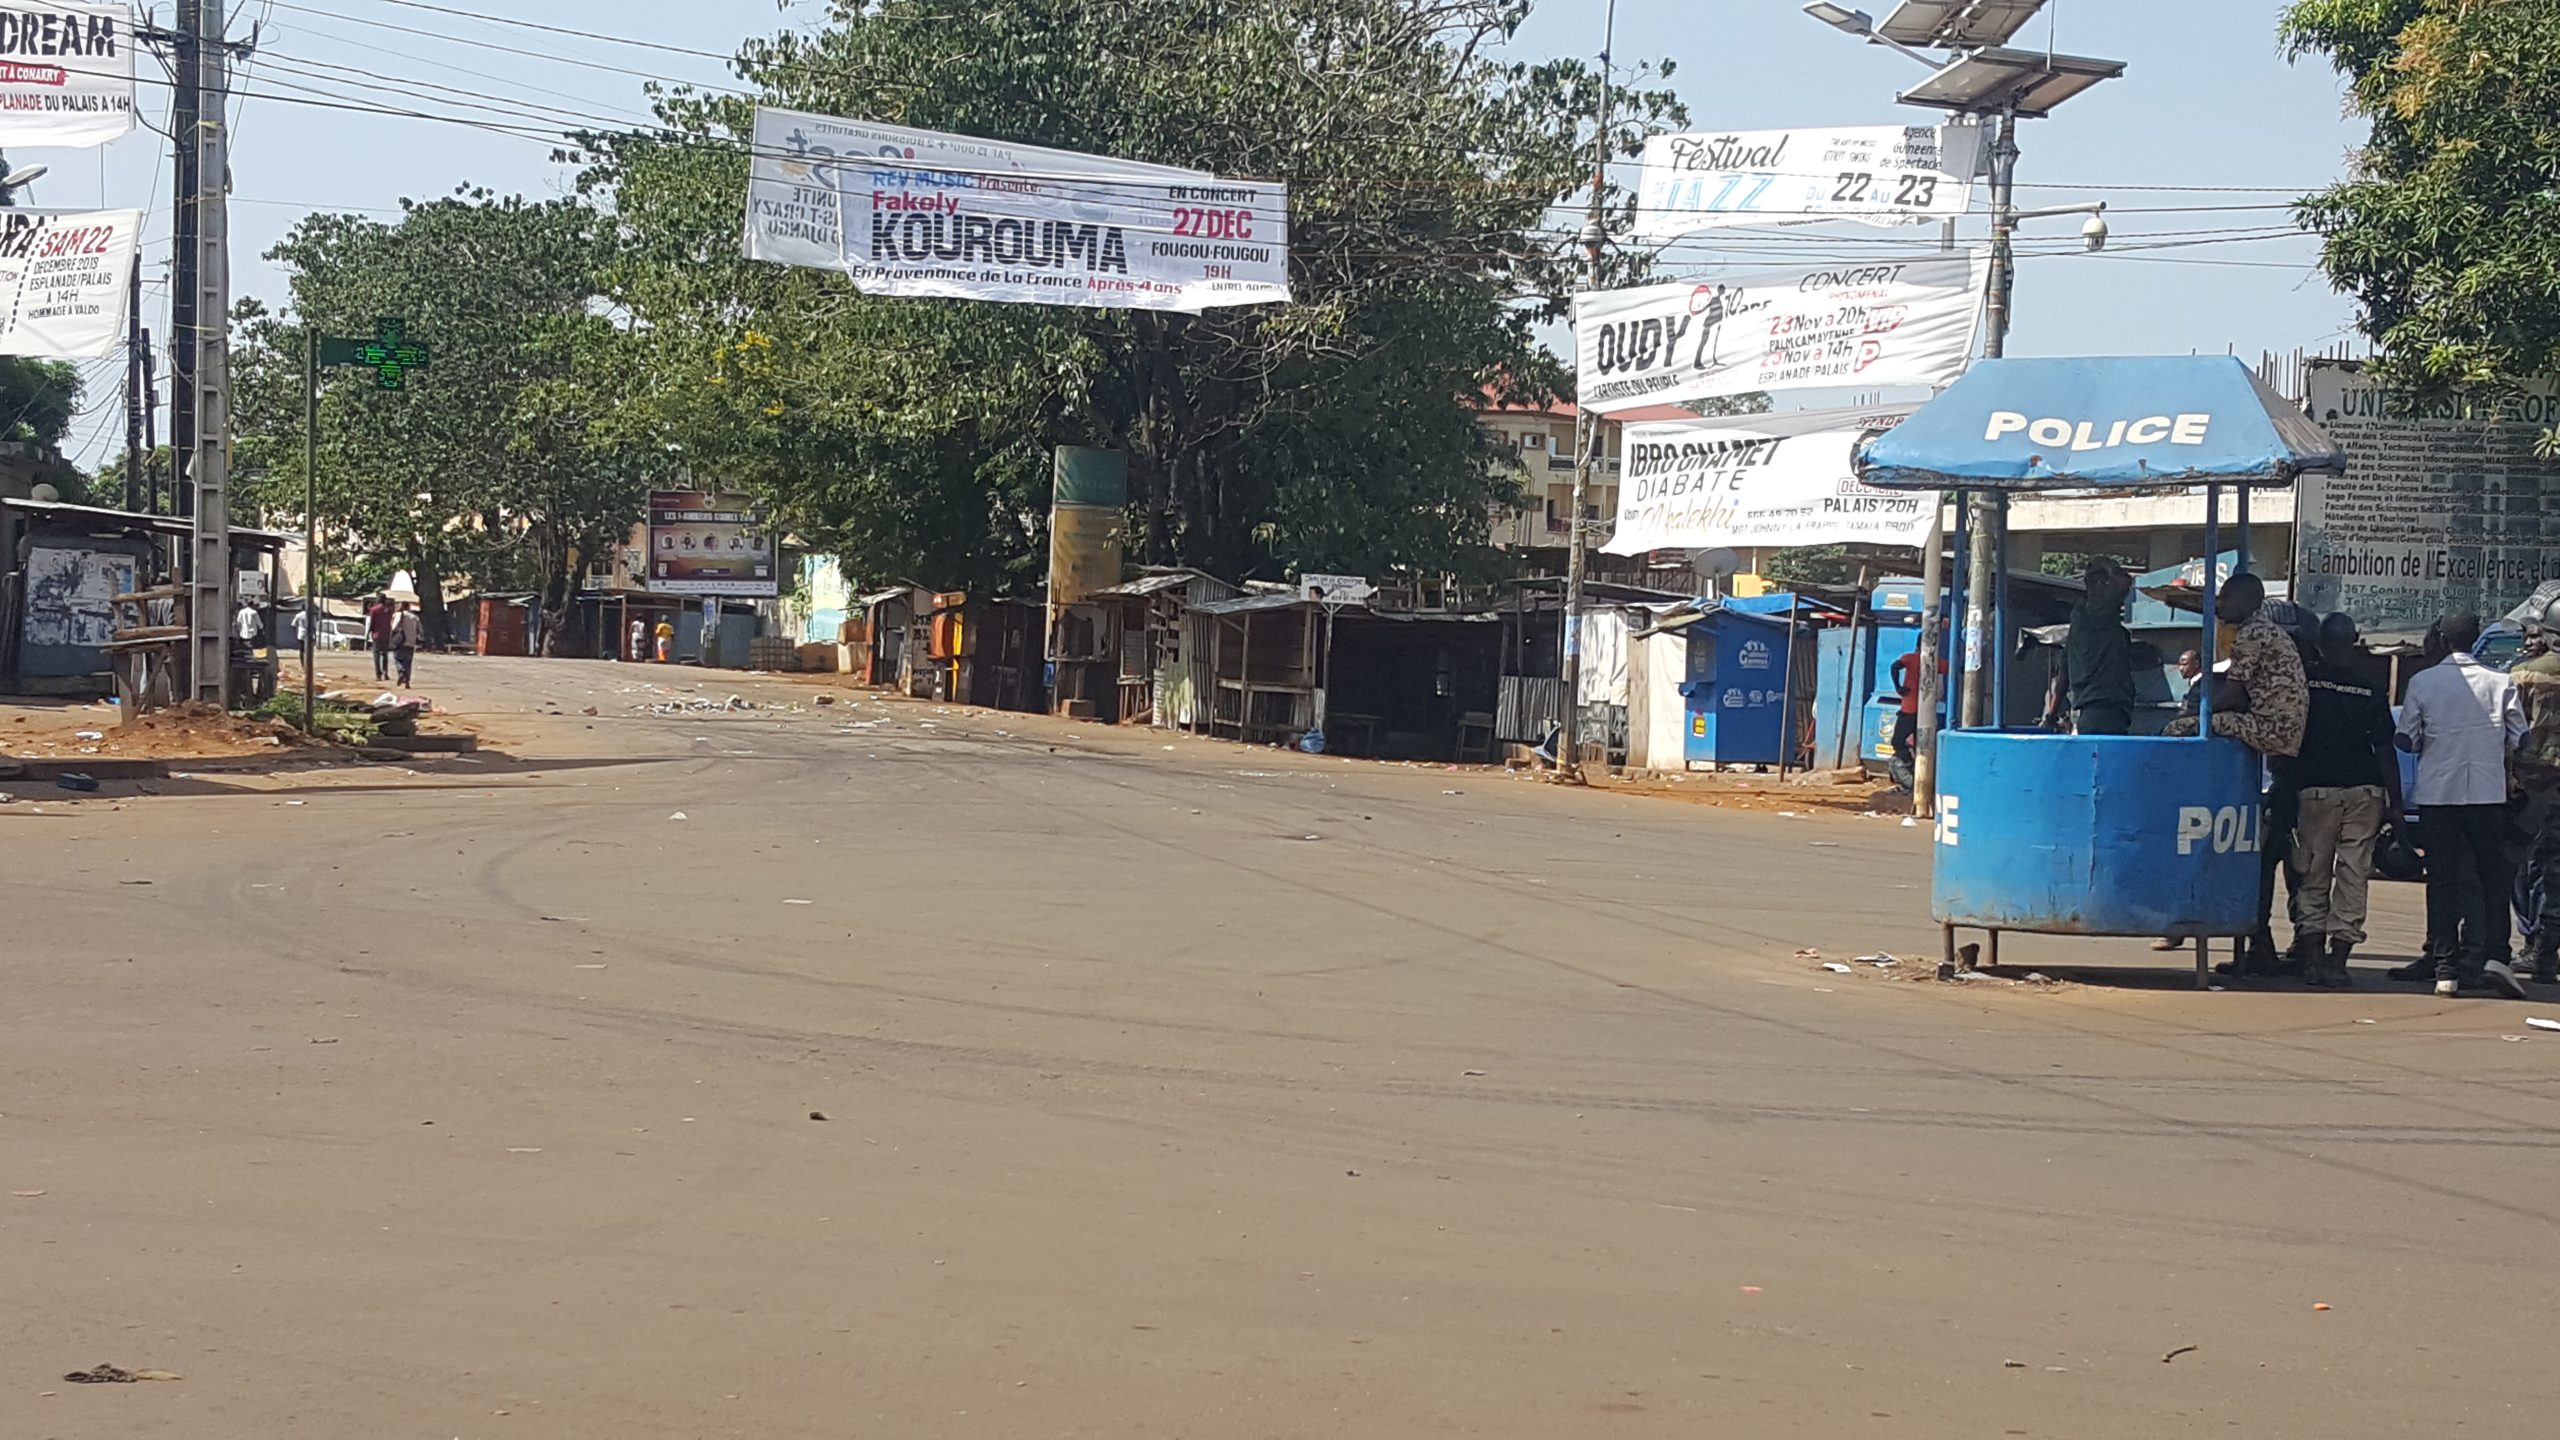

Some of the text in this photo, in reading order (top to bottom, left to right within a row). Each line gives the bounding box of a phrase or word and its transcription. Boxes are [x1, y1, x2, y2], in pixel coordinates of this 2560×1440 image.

[0, 11, 116, 58] DREAM
[16, 67, 59, 82] CONAKRY
[45, 95, 59, 112] DU
[62, 95, 98, 112] PALAIS
[111, 95, 131, 113] 14H
[1902, 125, 1936, 142] Agence
[1670, 133, 1790, 174] Festival
[1879, 157, 1891, 169] de
[915, 173, 974, 188] MUSIC
[1169, 185, 1257, 204] EN CONCERT
[1831, 172, 1872, 201] 22
[1894, 174, 1938, 207] 23
[1658, 174, 1776, 218] JAZZ
[1172, 207, 1254, 240] 27 DEC
[871, 212, 1129, 276] KOUROUMA
[851, 264, 872, 281] En
[874, 265, 977, 283] Provenance
[980, 269, 1000, 283] de
[1004, 271, 1023, 285] La
[1026, 271, 1083, 289] France
[1154, 281, 1183, 295] ans
[1203, 264, 1233, 280] 19H
[1800, 264, 1907, 293] CONCERT
[57, 289, 79, 303] 14H
[28, 305, 66, 320] HOMMAGE
[75, 304, 100, 315] VALDO
[1597, 314, 1692, 377] OUDY
[1983, 411, 2210, 451] POLICE
[2362, 432, 2377, 440] des
[1636, 468, 1748, 503] DIABATE
[2307, 547, 2396, 577] L'ambition
[2400, 549, 2421, 577] de
[2425, 550, 2526, 580] l'Excellence
[2531, 555, 2546, 581] et
[2370, 585, 2419, 597] Conakry
